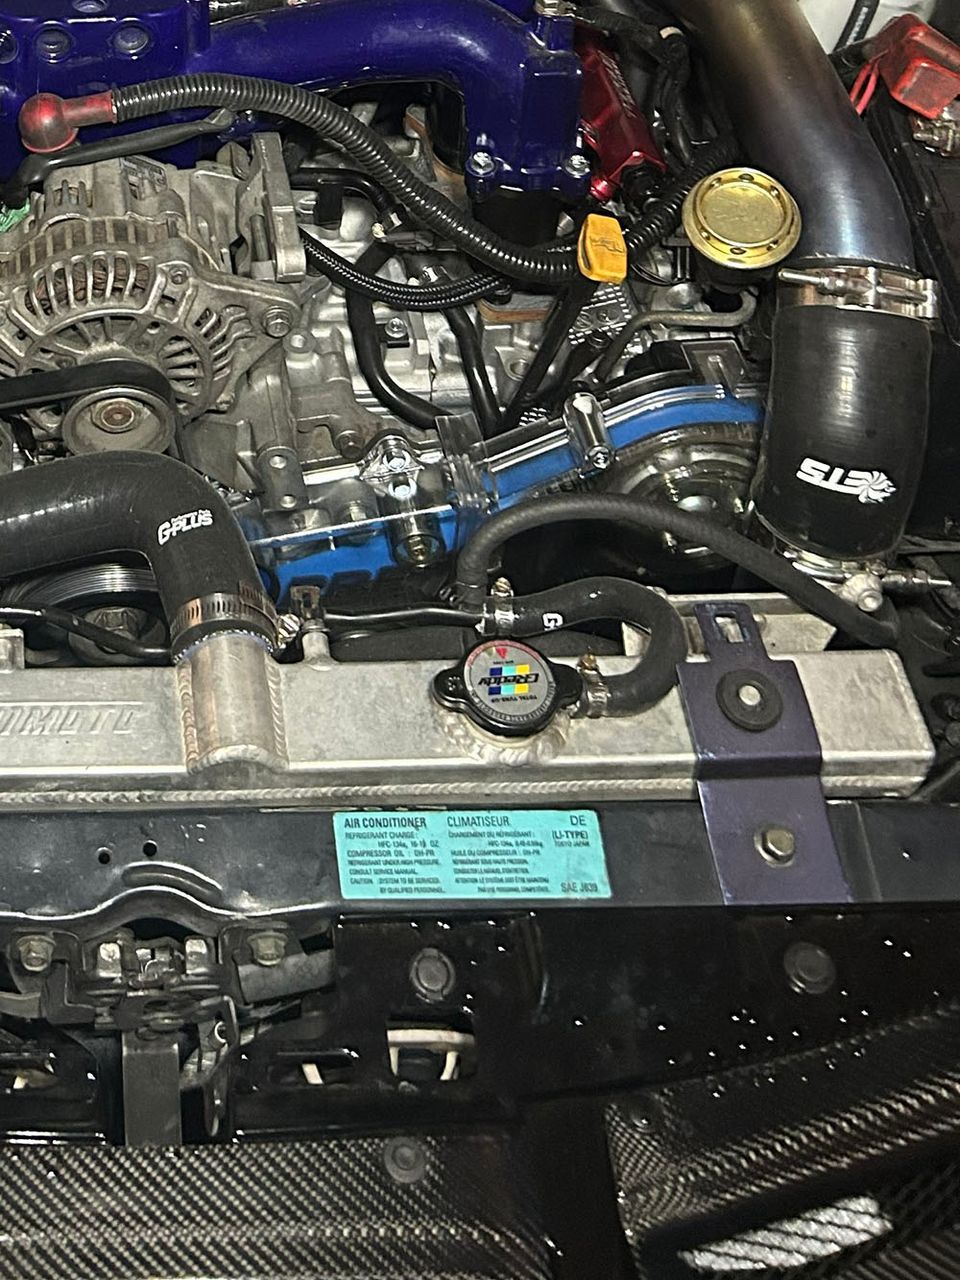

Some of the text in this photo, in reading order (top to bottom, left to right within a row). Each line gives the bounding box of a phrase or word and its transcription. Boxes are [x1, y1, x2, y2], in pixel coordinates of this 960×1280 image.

[478, 672, 540, 687] GReddy
[344, 816, 427, 829] AIR CONDITIONER
[446, 815, 510, 828] CLIMATISEUR
[569, 815, 587, 826] DE
[344, 831, 388, 839] REFRIGERANT
[552, 829, 589, 840] (U-TYPE)
[560, 882, 578, 893] SAE
